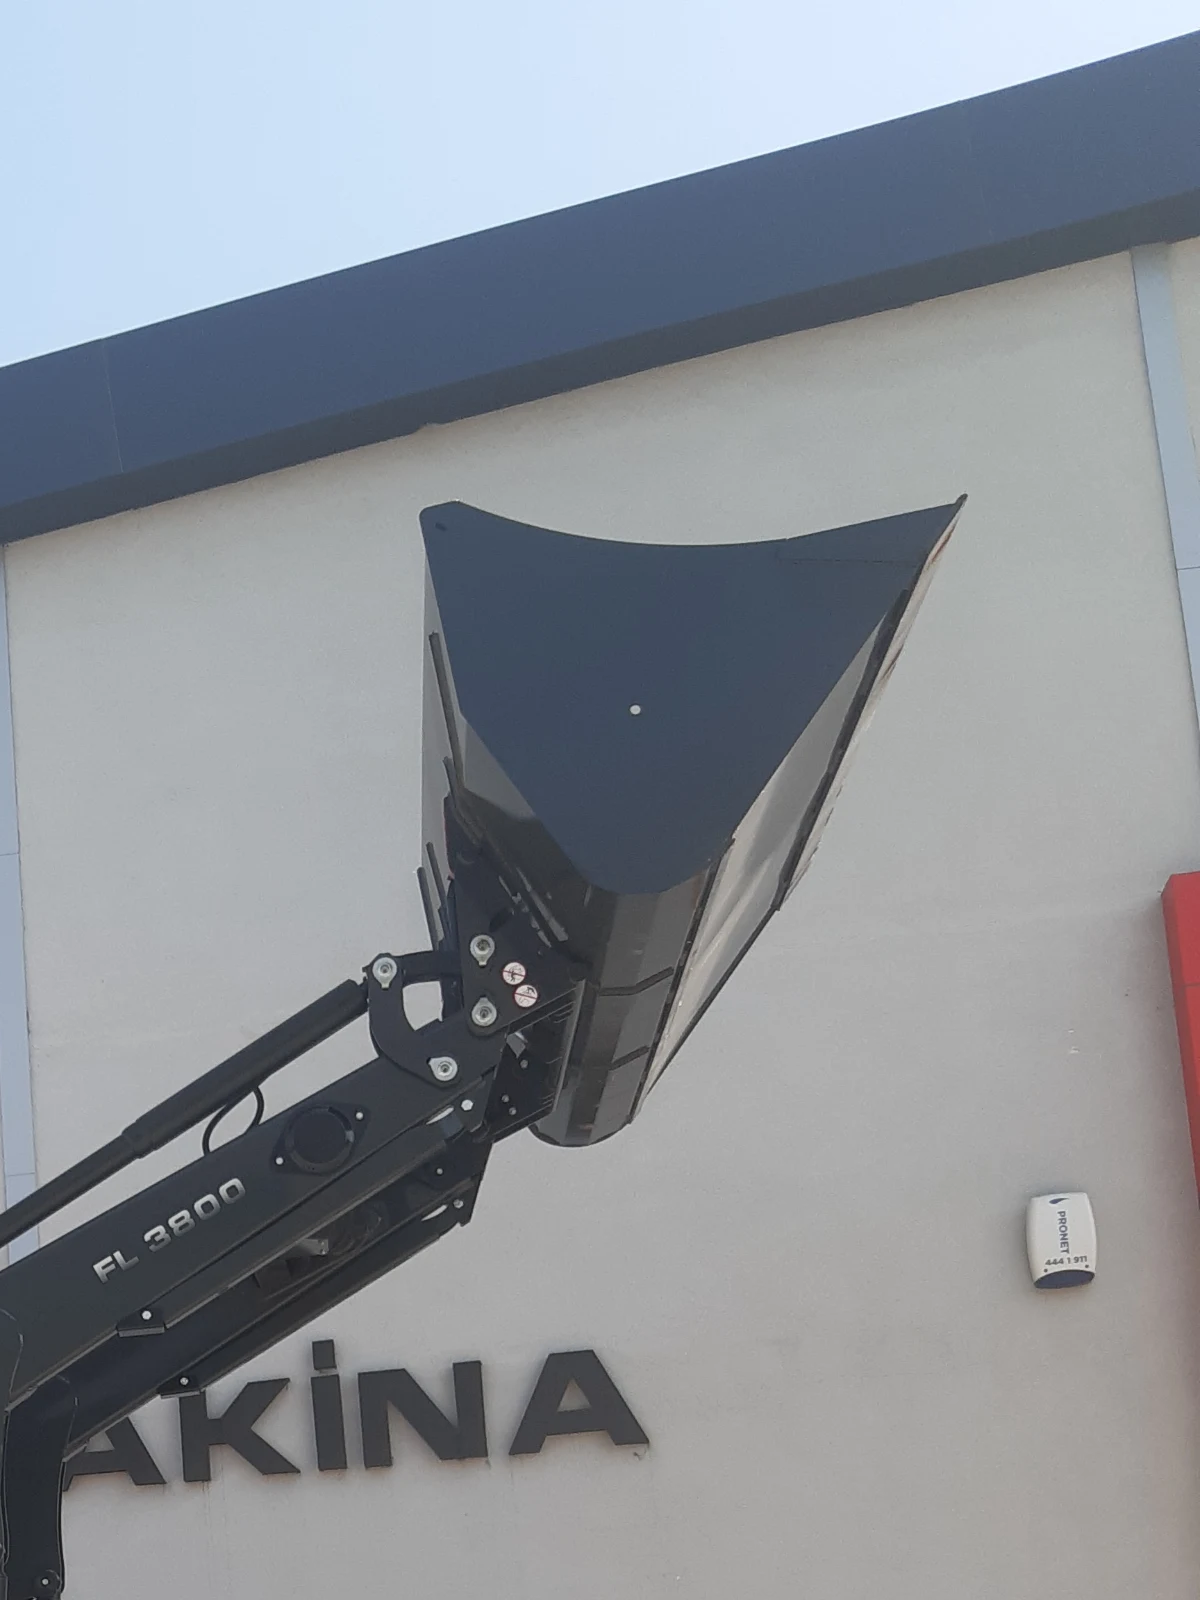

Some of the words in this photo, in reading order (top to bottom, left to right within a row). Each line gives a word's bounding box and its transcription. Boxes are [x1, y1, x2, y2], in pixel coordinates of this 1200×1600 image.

[92, 1250, 140, 1284] FL
[143, 1177, 246, 1253] 3800
[1045, 1257, 1064, 1266] 444
[1073, 1255, 1088, 1264] 911
[1057, 1210, 1070, 1255] PRONET
[63, 1339, 650, 1491] AKİNA
